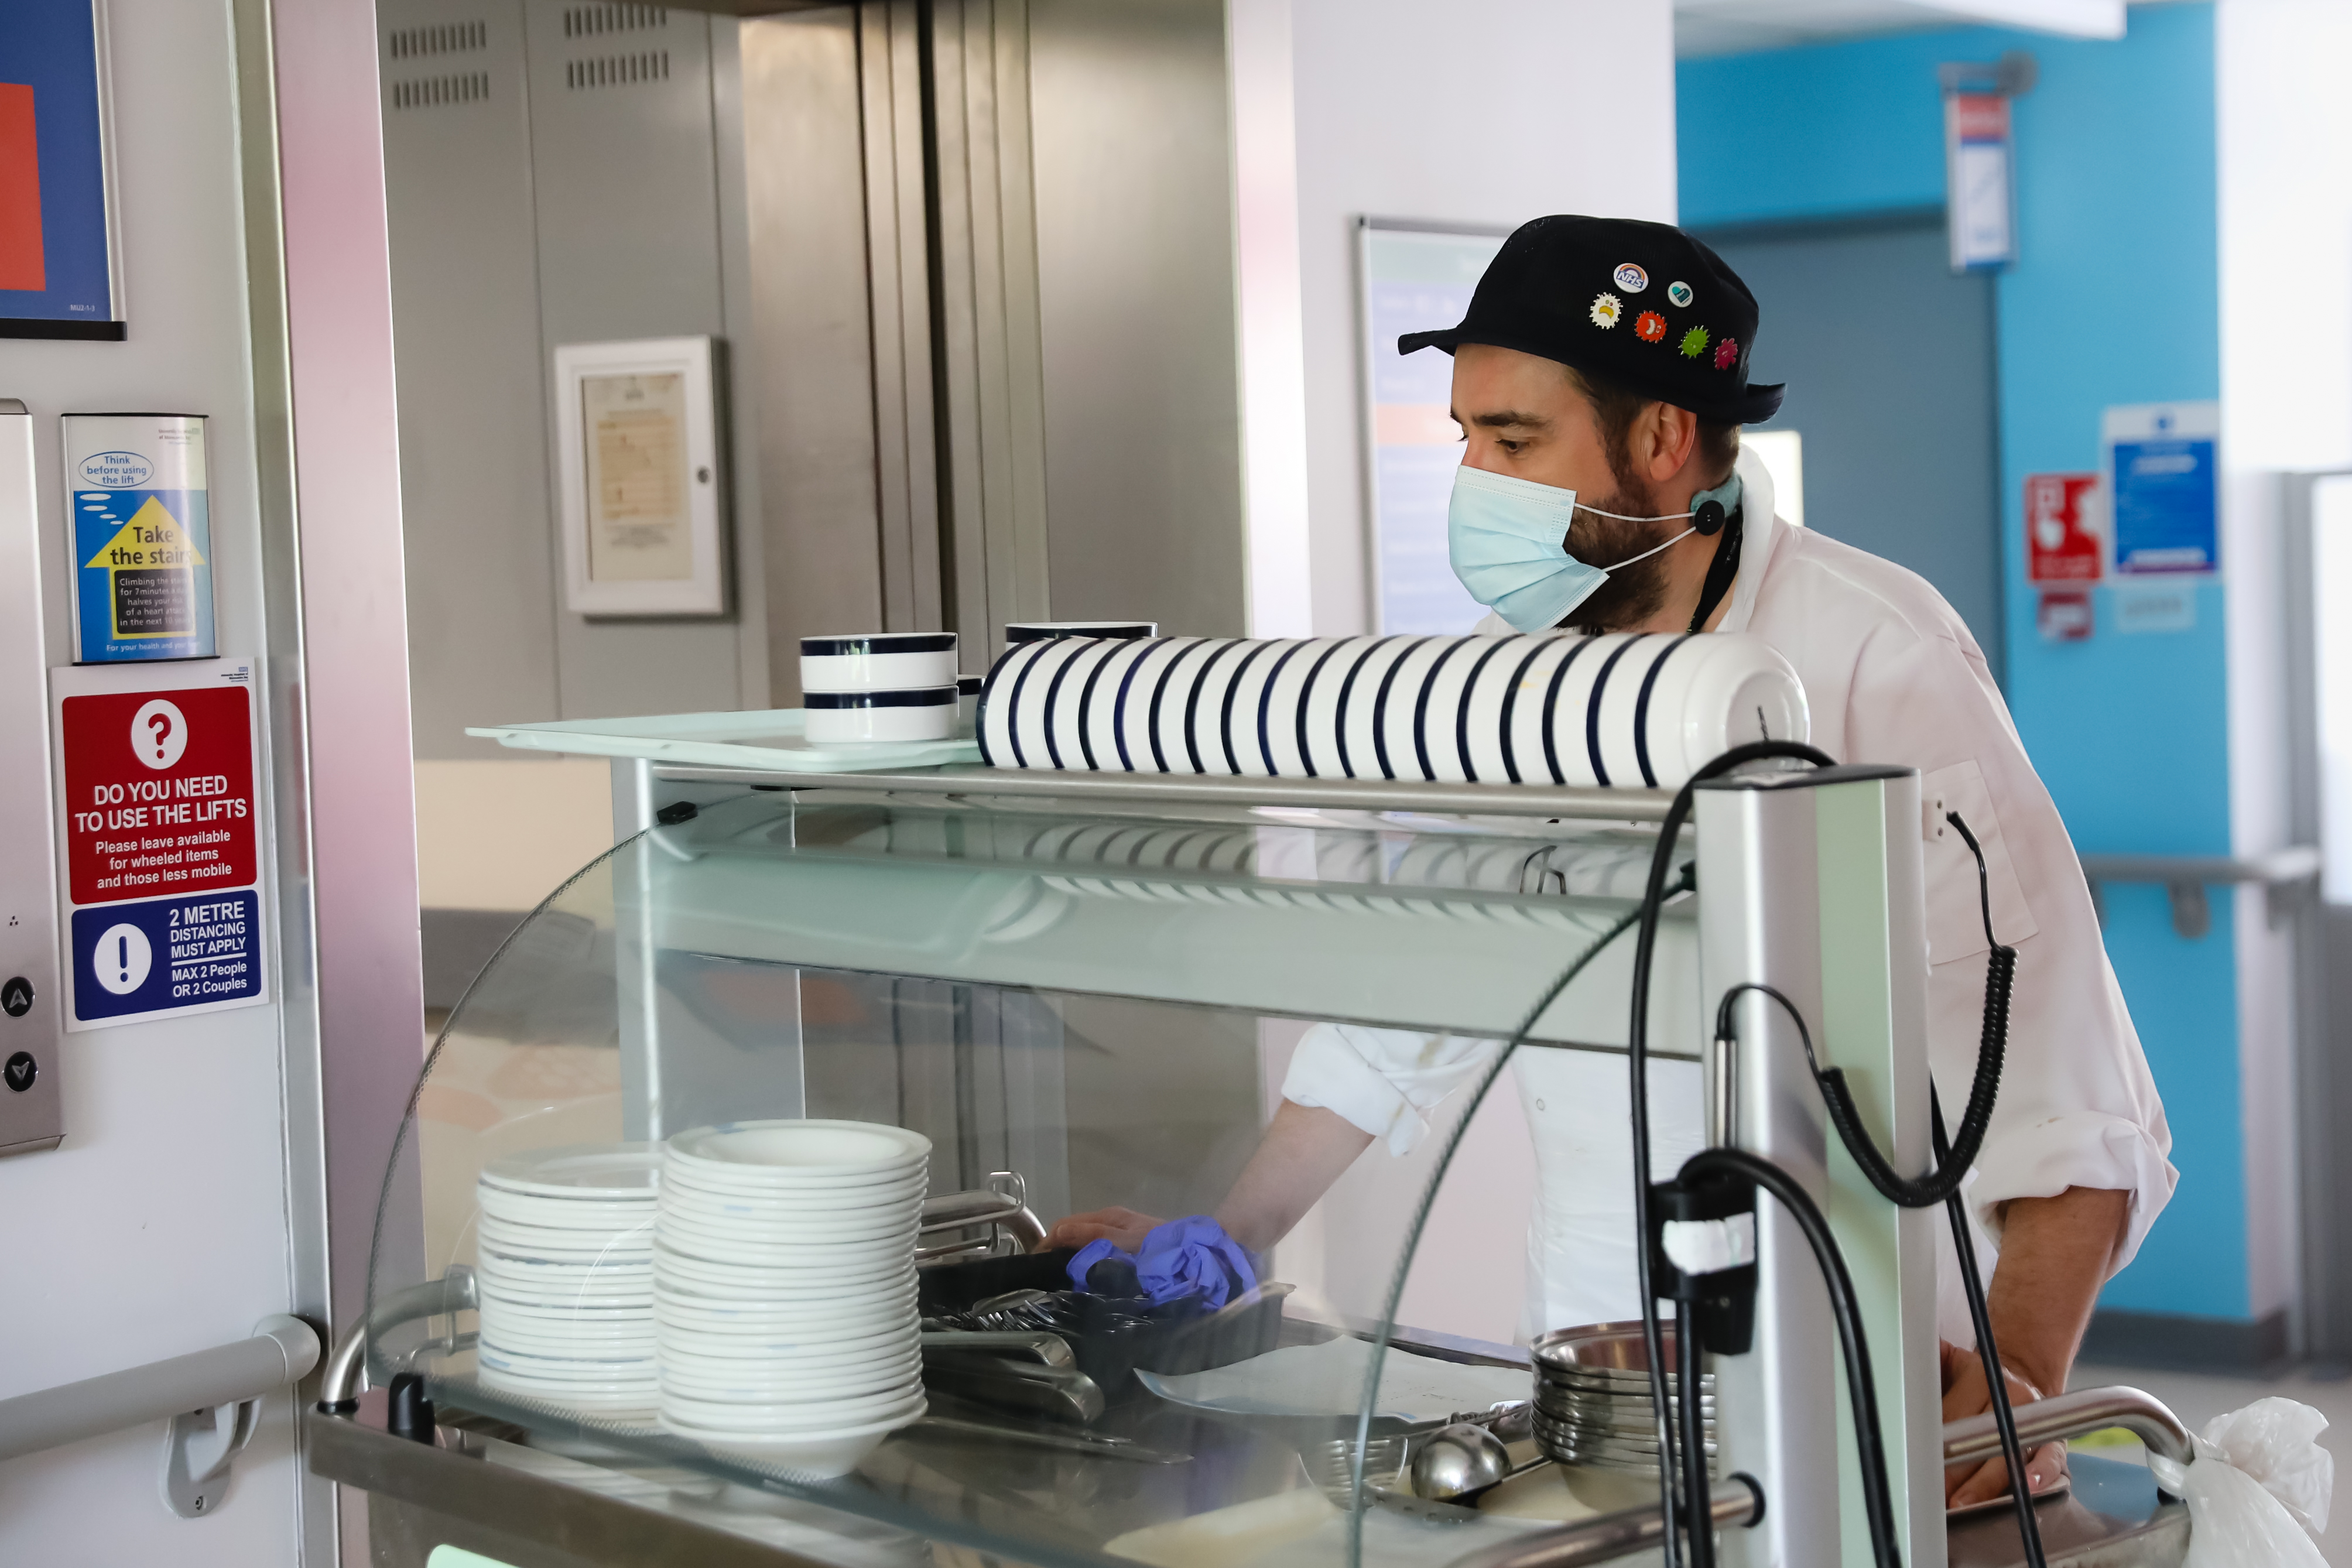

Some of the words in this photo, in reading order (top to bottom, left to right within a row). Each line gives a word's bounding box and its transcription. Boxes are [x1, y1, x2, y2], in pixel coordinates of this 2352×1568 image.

[1617, 272, 1644, 287] NHS
[104, 456, 130, 464] Think
[87, 465, 119, 474] before
[122, 465, 146, 476] using
[102, 475, 118, 484] the
[121, 475, 134, 484] lift
[133, 525, 174, 543] Take
[110, 547, 143, 564] the
[119, 577, 155, 587] Climbing
[157, 577, 168, 585] the
[154, 598, 170, 607] your
[94, 783, 125, 805] DO
[128, 779, 170, 802] YOU
[176, 775, 228, 797] NEED
[75, 811, 103, 833] TO
[108, 807, 149, 830] USE
[152, 803, 191, 826] THE
[196, 797, 247, 821] LIFTS
[95, 840, 138, 854] Please
[141, 837, 174, 850] leave
[177, 829, 231, 846] available
[109, 857, 128, 870] for
[131, 850, 182, 868] wheeled
[186, 849, 219, 862] items
[97, 874, 121, 889] and
[124, 872, 159, 886] those
[163, 869, 188, 881] less
[191, 862, 232, 878] mobile
[169, 909, 180, 926] 2
[184, 901, 245, 925] METRE
[170, 921, 246, 943] DISTANCING
[171, 942, 206, 958] MUST
[207, 936, 246, 954] APPLY
[172, 967, 198, 981] MAX
[200, 966, 207, 978] 2
[210, 961, 247, 977] People
[173, 984, 191, 998] OR
[193, 982, 200, 995] 2
[203, 977, 247, 993] Couples
